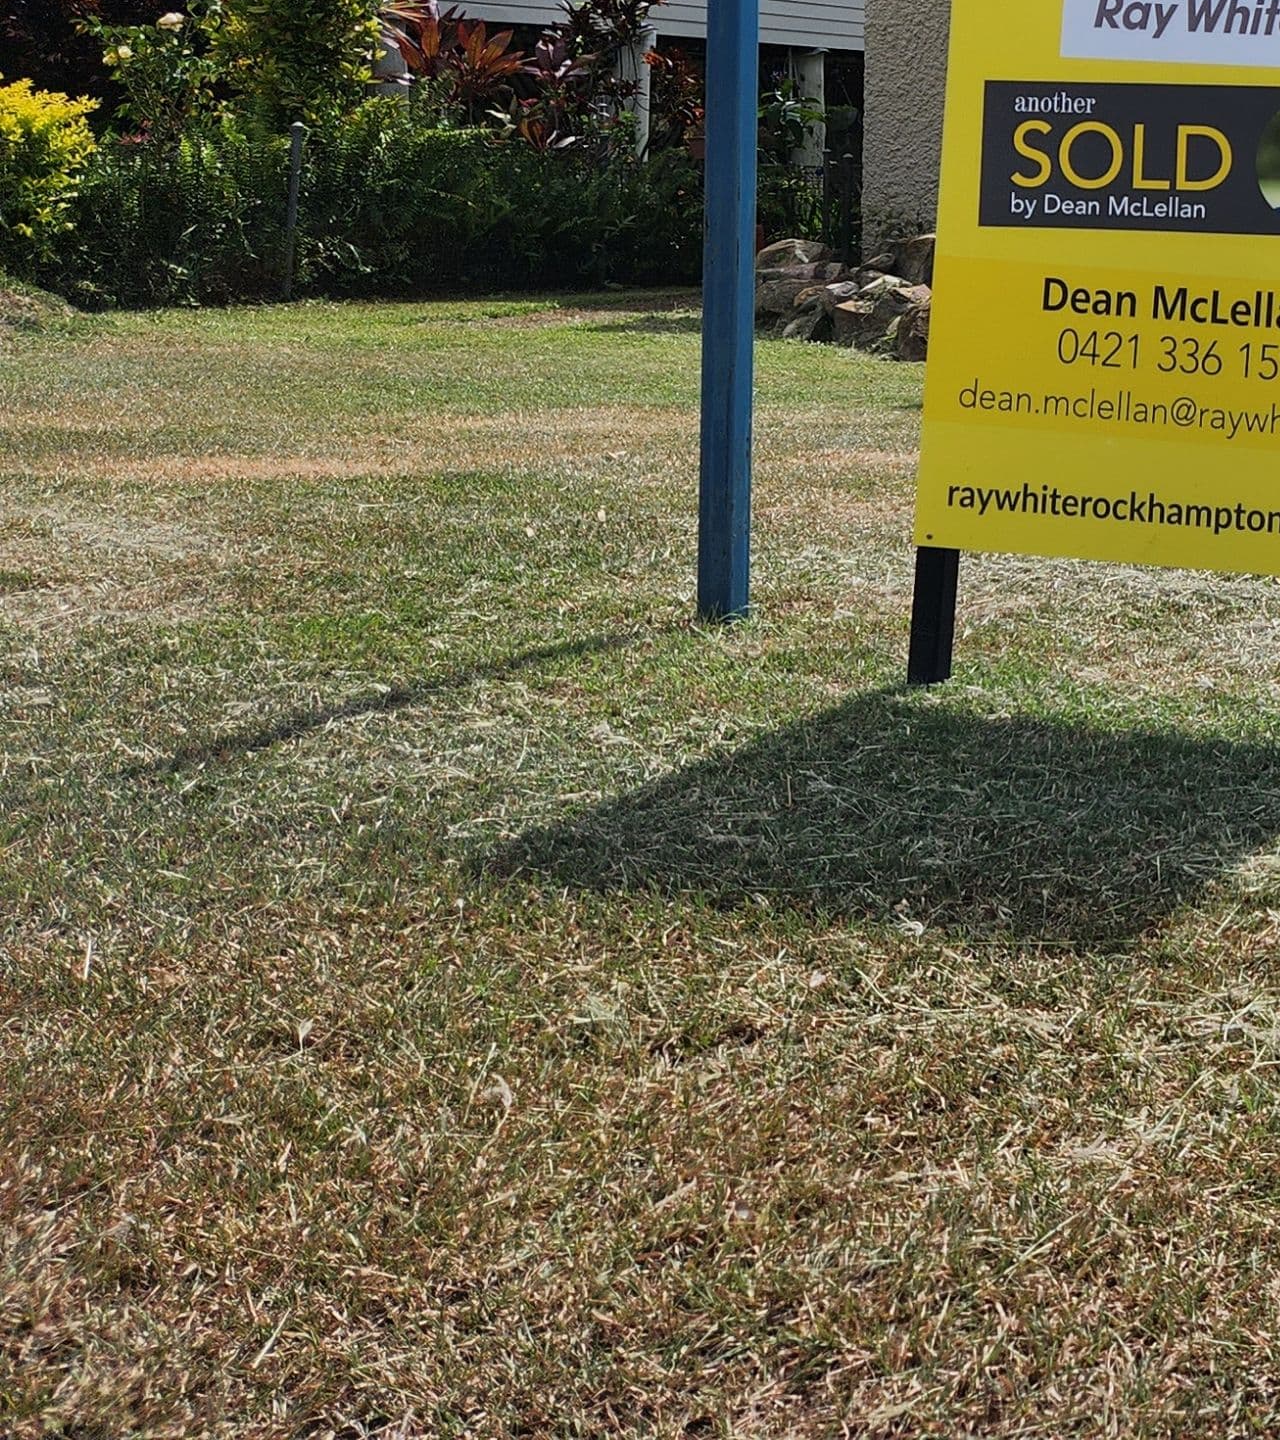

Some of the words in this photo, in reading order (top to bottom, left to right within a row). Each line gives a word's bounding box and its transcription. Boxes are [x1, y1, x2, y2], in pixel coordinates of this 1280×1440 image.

[1014, 91, 1096, 114] another
[1011, 120, 1233, 190] SOLD
[1010, 192, 1036, 218] by
[1044, 194, 1100, 215] Dean
[1108, 196, 1206, 219] McLellan
[1042, 277, 1137, 317] Dean
[1058, 328, 1139, 368] 0421
[1158, 335, 1222, 376] 336
